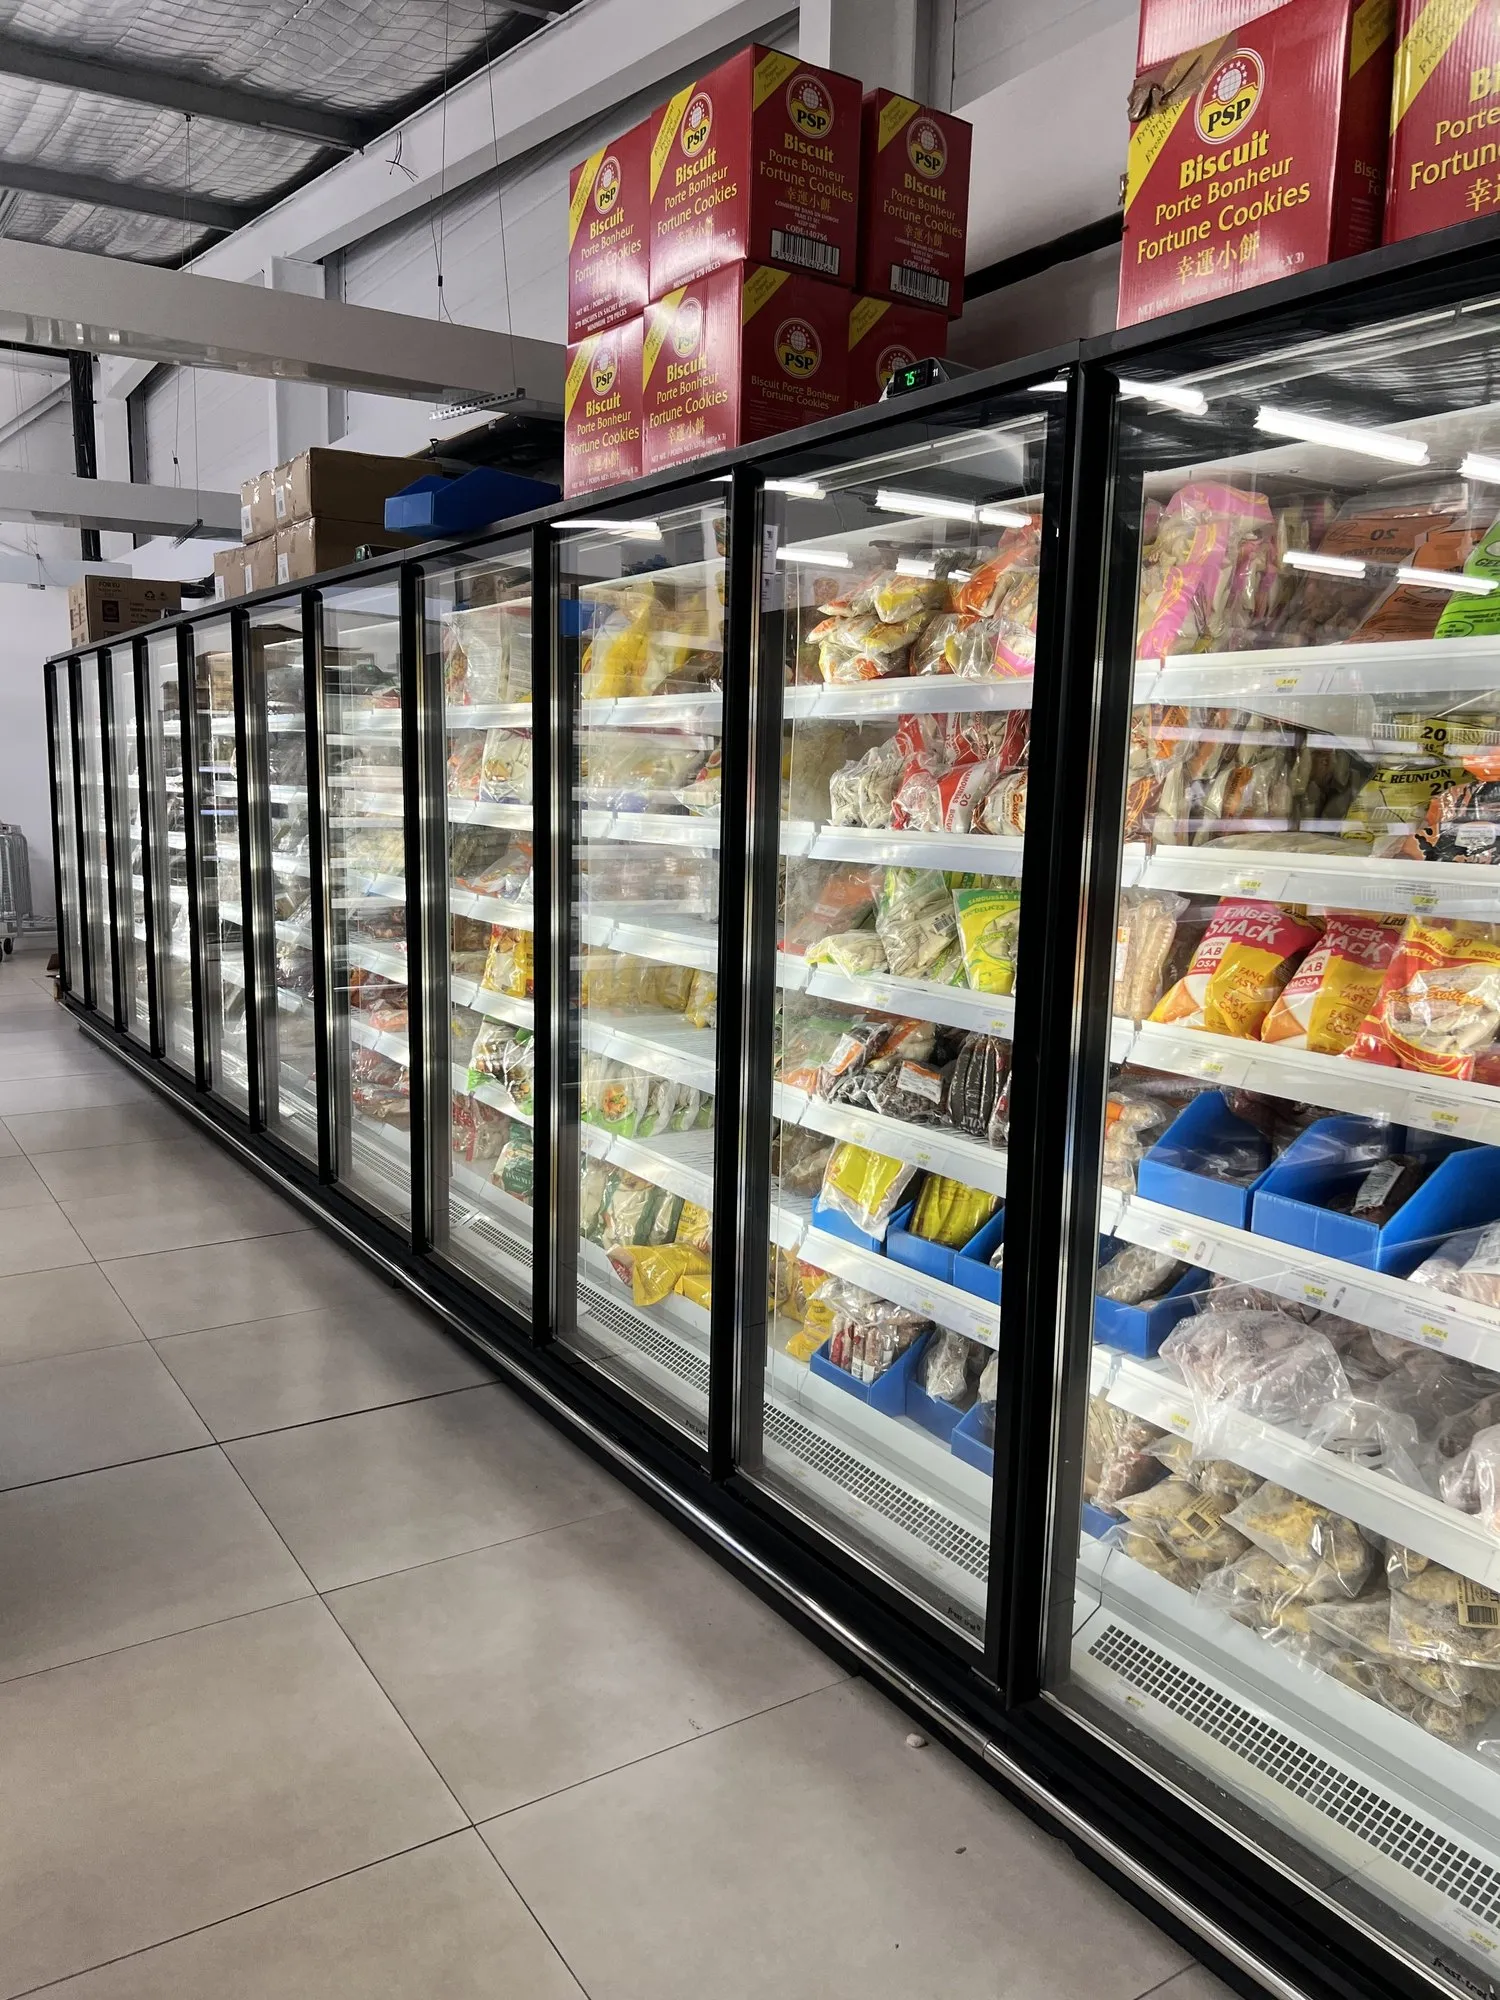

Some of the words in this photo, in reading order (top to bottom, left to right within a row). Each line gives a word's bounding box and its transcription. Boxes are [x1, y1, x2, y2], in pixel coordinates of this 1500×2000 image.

[797, 109, 826, 131] PSP
[1207, 98, 1250, 133] PSP
[687, 126, 706, 149] PSP
[784, 132, 834, 164] Biscuit
[675, 148, 717, 186] Biscuit
[769, 149, 799, 168] Porte
[802, 158, 845, 183] Bonheur
[915, 150, 941, 170] PSP
[1179, 129, 1270, 189] Biscuit
[1354, 159, 1383, 181] Bisc
[1409, 142, 1500, 191] Fortun
[664, 189, 686, 211] Porte
[689, 165, 728, 194] Bonheur
[760, 161, 806, 187] Fortune
[809, 177, 854, 203] Cookies
[904, 172, 947, 202] Biscuit
[1155, 194, 1201, 225] Porte
[1208, 156, 1293, 204] Bonheur
[599, 187, 616, 207] PSP
[657, 208, 691, 237] Fortune
[694, 182, 737, 215] Cookies
[891, 188, 916, 208] Porte
[918, 197, 956, 221] Bonheur
[590, 207, 624, 240] Biscuit
[883, 199, 922, 225] Fortune
[924, 213, 963, 239] Cookies
[1137, 219, 1211, 264] Fortune
[1218, 182, 1310, 232] Cookies
[581, 245, 599, 261] Porte
[601, 224, 634, 249] Bonheur
[606, 240, 641, 265] Cookies
[1176, 231, 1260, 284] 幸運小餅
[666, 354, 707, 383] Biscuit
[784, 352, 814, 369] PSP
[595, 371, 613, 388] PSP
[656, 385, 677, 404] Porte
[679, 371, 719, 395] Bonheur
[751, 375, 779, 391] Biscuit
[782, 381, 805, 396] Porte
[807, 384, 840, 402] Bonheur
[585, 392, 621, 418] Biscuit
[650, 405, 683, 429] Fortune
[685, 388, 728, 415] Cookies
[762, 388, 794, 403] Fortune
[797, 395, 830, 410] Cookies
[577, 418, 596, 436] Porte
[597, 410, 631, 432] Bonheur
[570, 438, 600, 457] Fortune
[602, 426, 640, 448] Cookies
[1420, 727, 1447, 741] 20
[960, 793, 971, 807] 20
[1223, 906, 1282, 926] FINGER
[1205, 919, 1285, 945] SNACK
[1454, 938, 1473, 948] 20
[1231, 975, 1262, 996] TASTE
[1345, 983, 1376, 996] FANC
[1223, 991, 1246, 1011] EASY
[1340, 990, 1371, 1008] TASTE
[1218, 1002, 1247, 1024] COOK
[1329, 1009, 1361, 1024] EASY
[1325, 1023, 1359, 1037] COO
